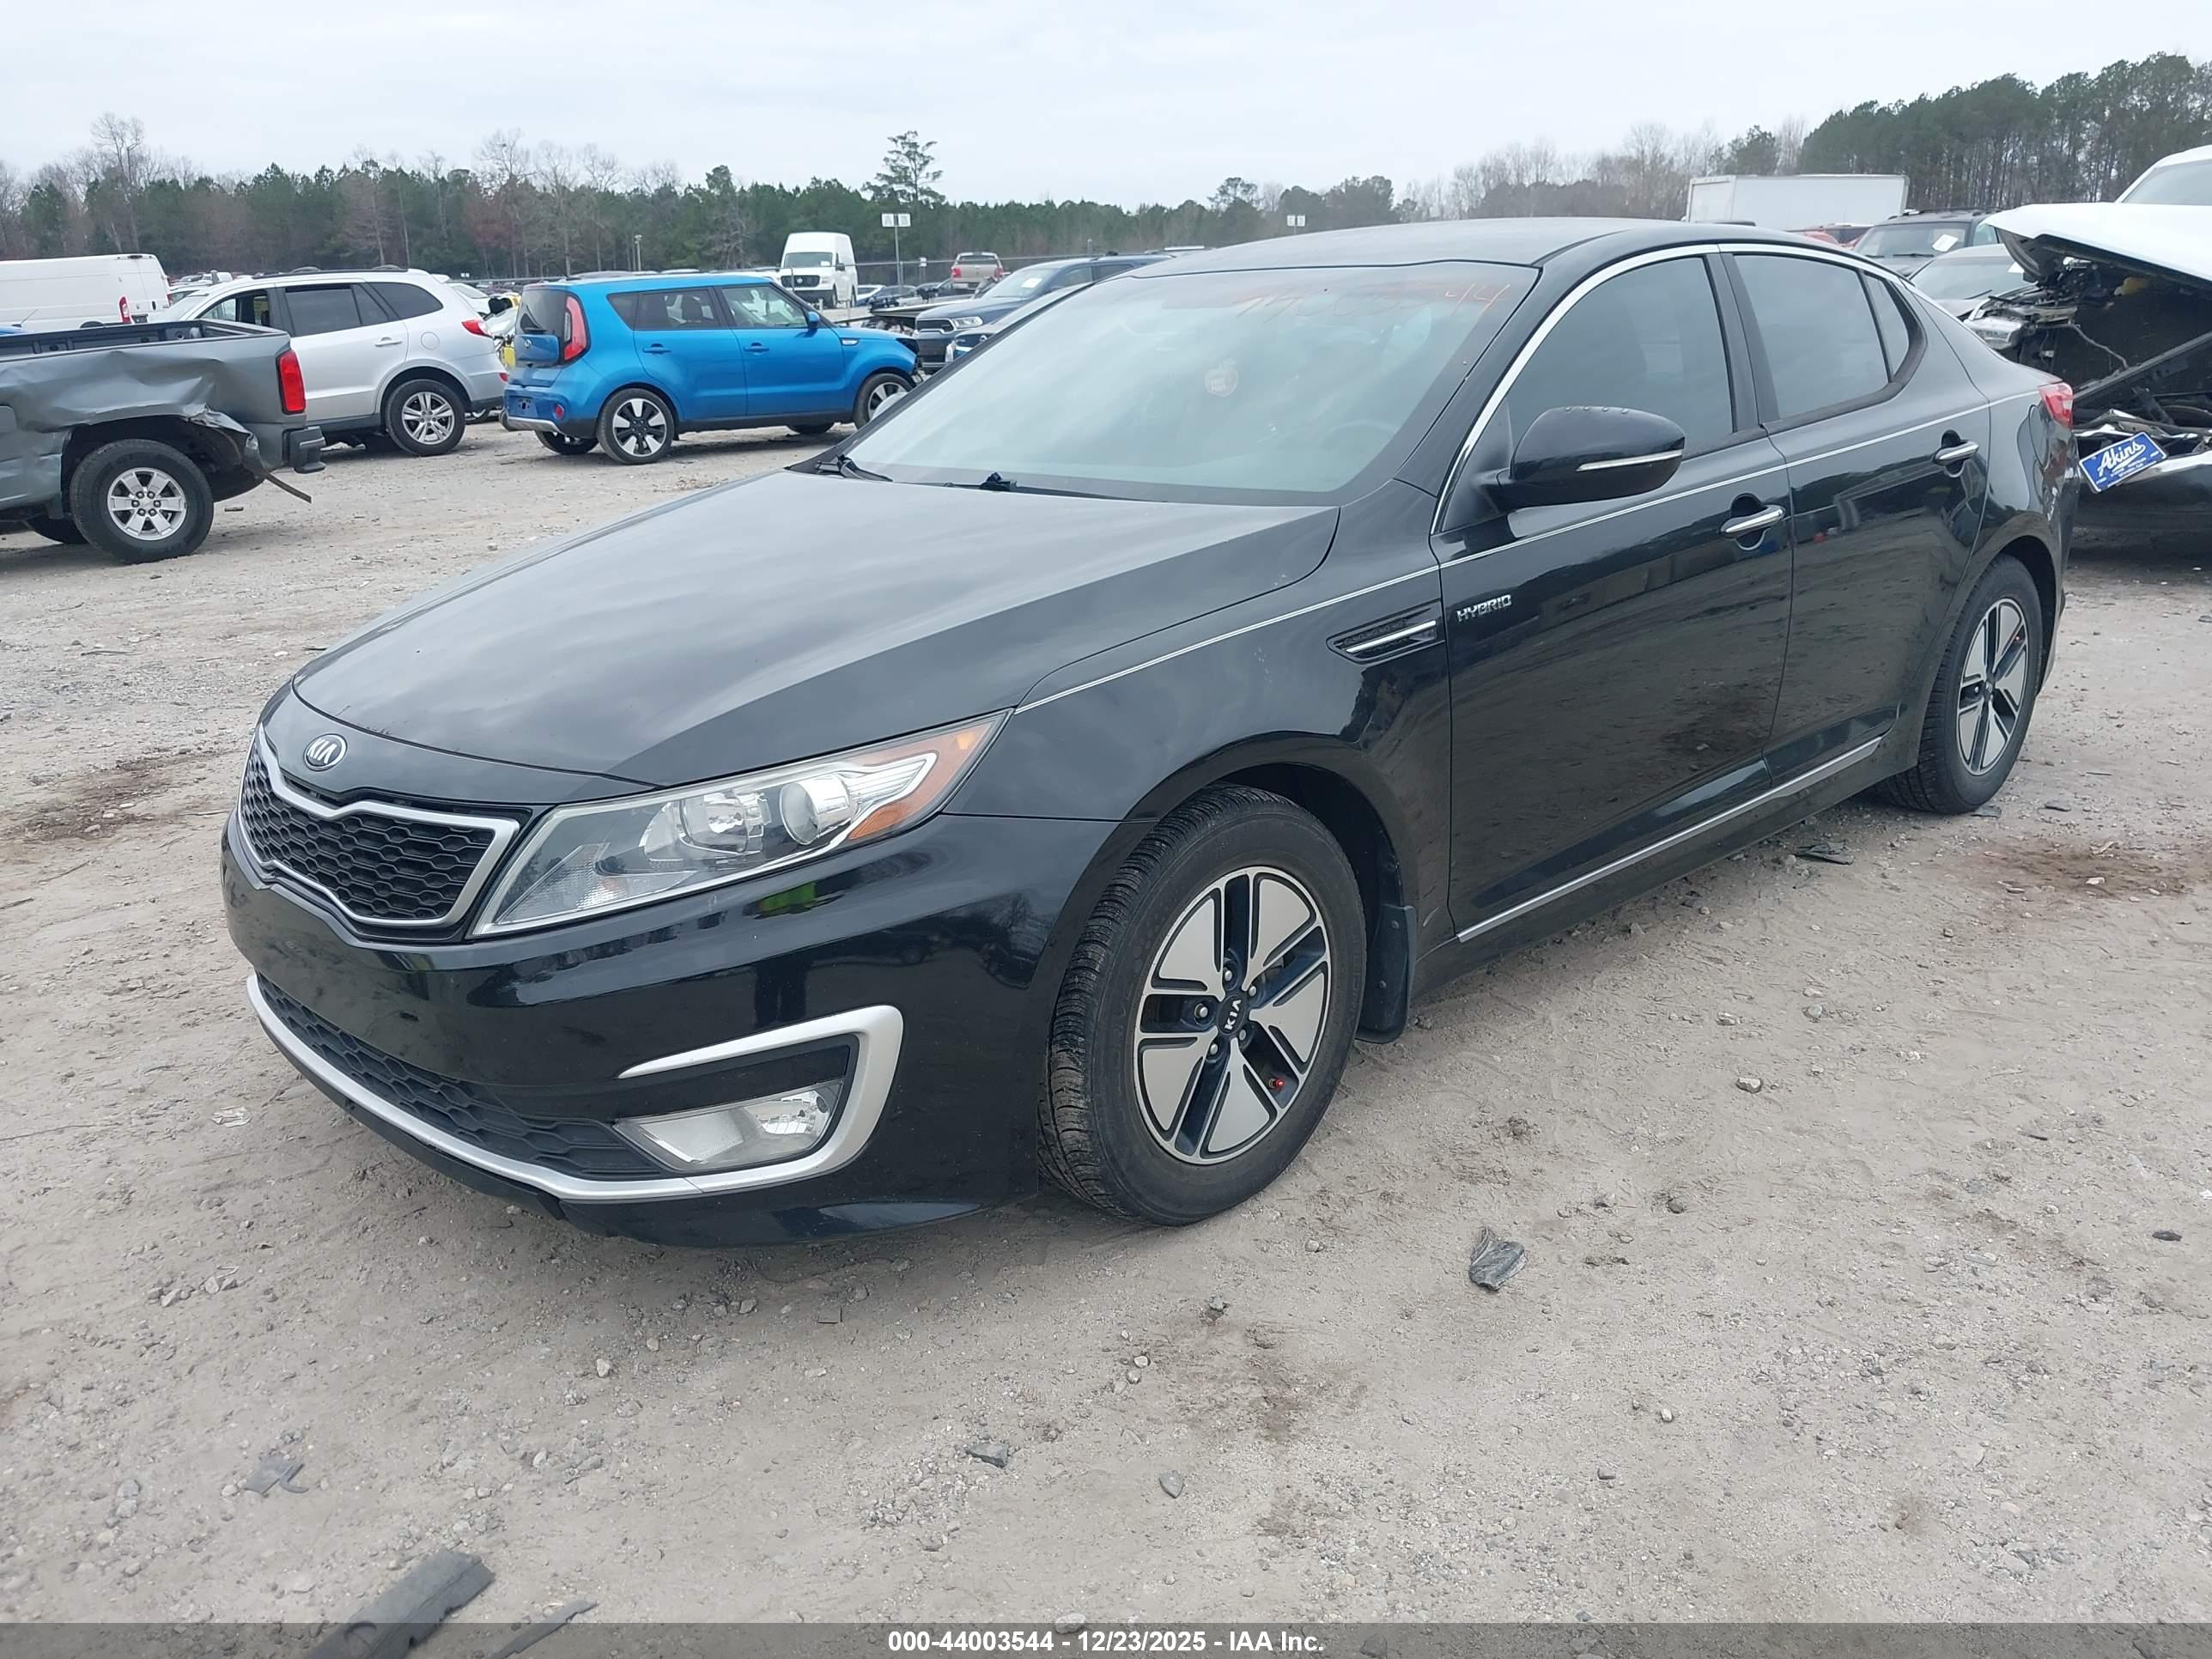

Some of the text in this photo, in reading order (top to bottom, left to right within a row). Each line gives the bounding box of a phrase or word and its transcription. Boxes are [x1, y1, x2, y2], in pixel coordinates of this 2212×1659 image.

[2097, 440, 2144, 477] Akins
[1456, 594, 1512, 623] HYBRID
[1224, 999, 1242, 1030] KIA
